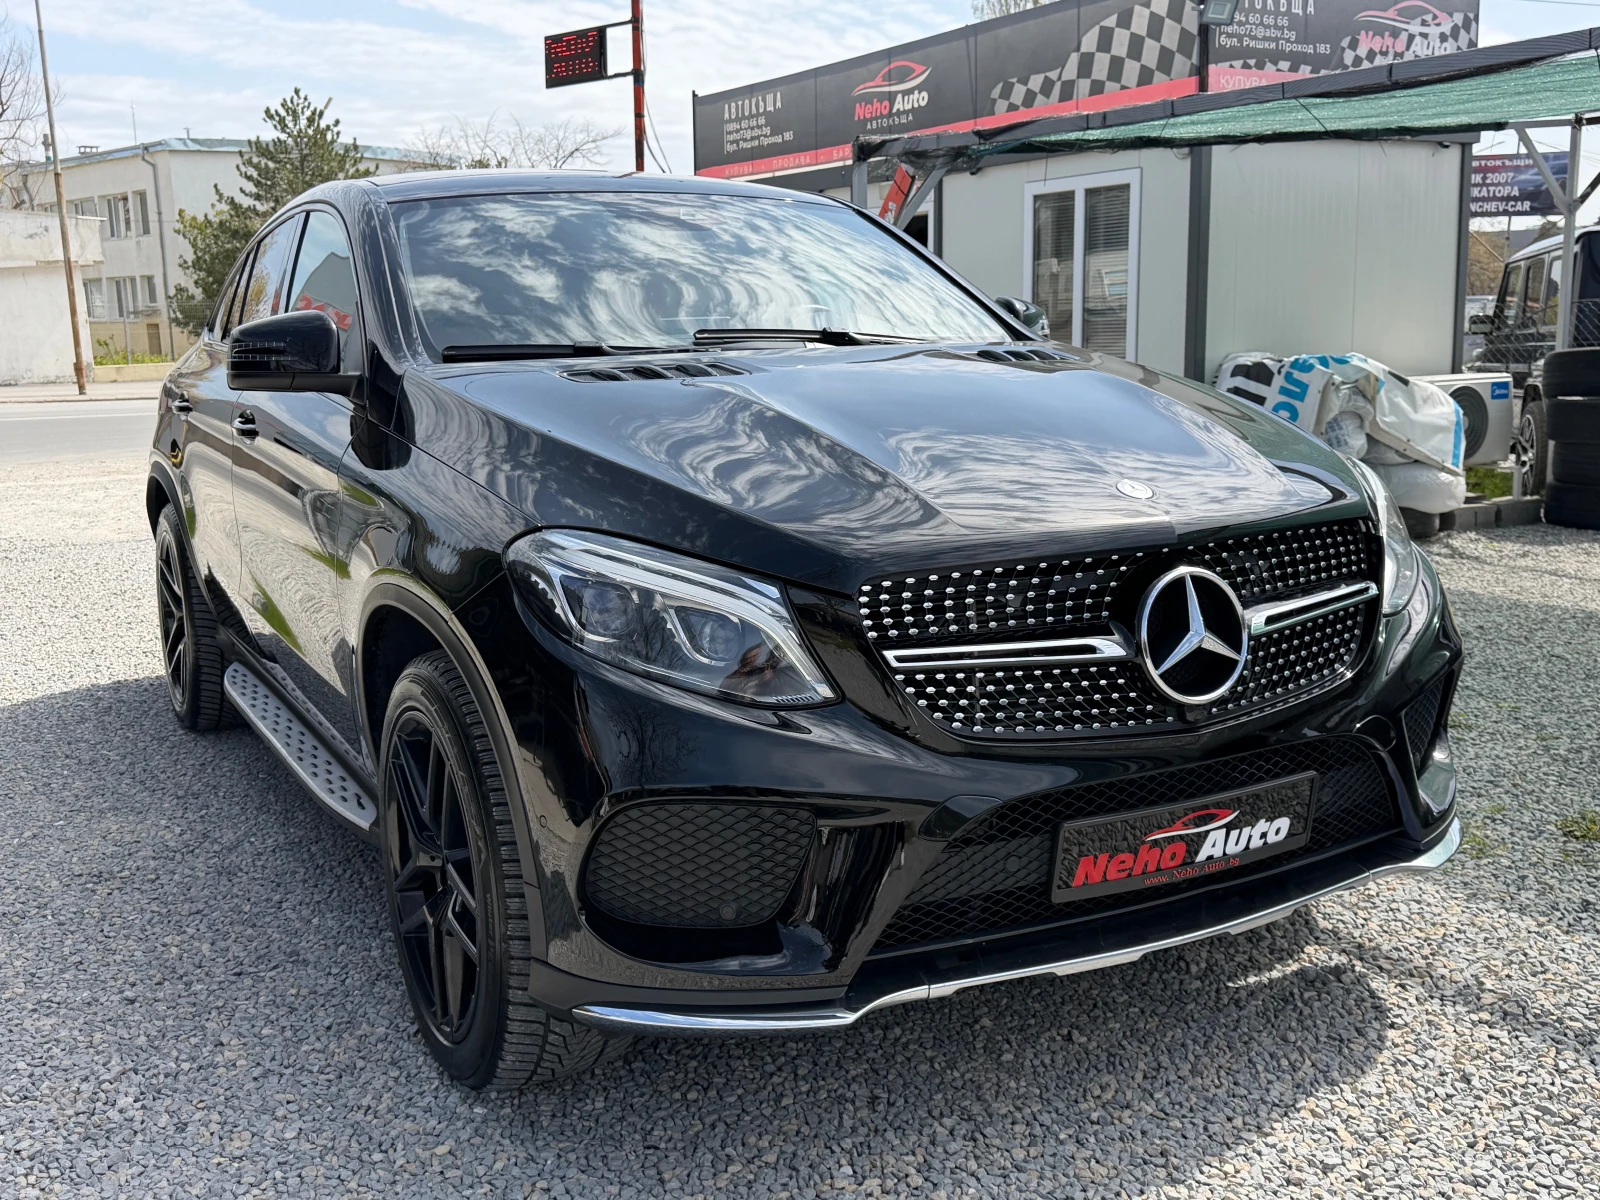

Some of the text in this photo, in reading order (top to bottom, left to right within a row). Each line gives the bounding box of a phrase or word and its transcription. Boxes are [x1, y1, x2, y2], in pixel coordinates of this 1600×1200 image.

[1248, 13, 1261, 24] 60
[1263, 14, 1275, 26] 66
[1277, 16, 1289, 27] 66
[1220, 23, 1296, 41] neho73@abv.bg
[1219, 34, 1331, 54] бул. Ришки Проход 183
[1358, 30, 1451, 58] Neho Auto
[724, 91, 782, 121] АВТОКЪЩА
[854, 89, 929, 121] Neho Auto
[726, 121, 741, 132] 0894
[741, 119, 749, 129] 60
[758, 115, 766, 125] 66
[866, 112, 913, 131] АВТОКЪЩА
[739, 138, 759, 150] Ришки
[783, 131, 794, 141] 183
[772, 155, 811, 169] ПРОДАВА
[832, 147, 850, 160] БАР
[1485, 172, 1515, 184] 2007
[1470, 186, 1519, 197] КАТОРА
[1470, 201, 1531, 212] NCHEV-CAR
[1072, 816, 1291, 888] Neho Auto
[1144, 874, 1169, 886] www.
[1171, 866, 1199, 881] Neho
[1201, 859, 1225, 874] Auto
